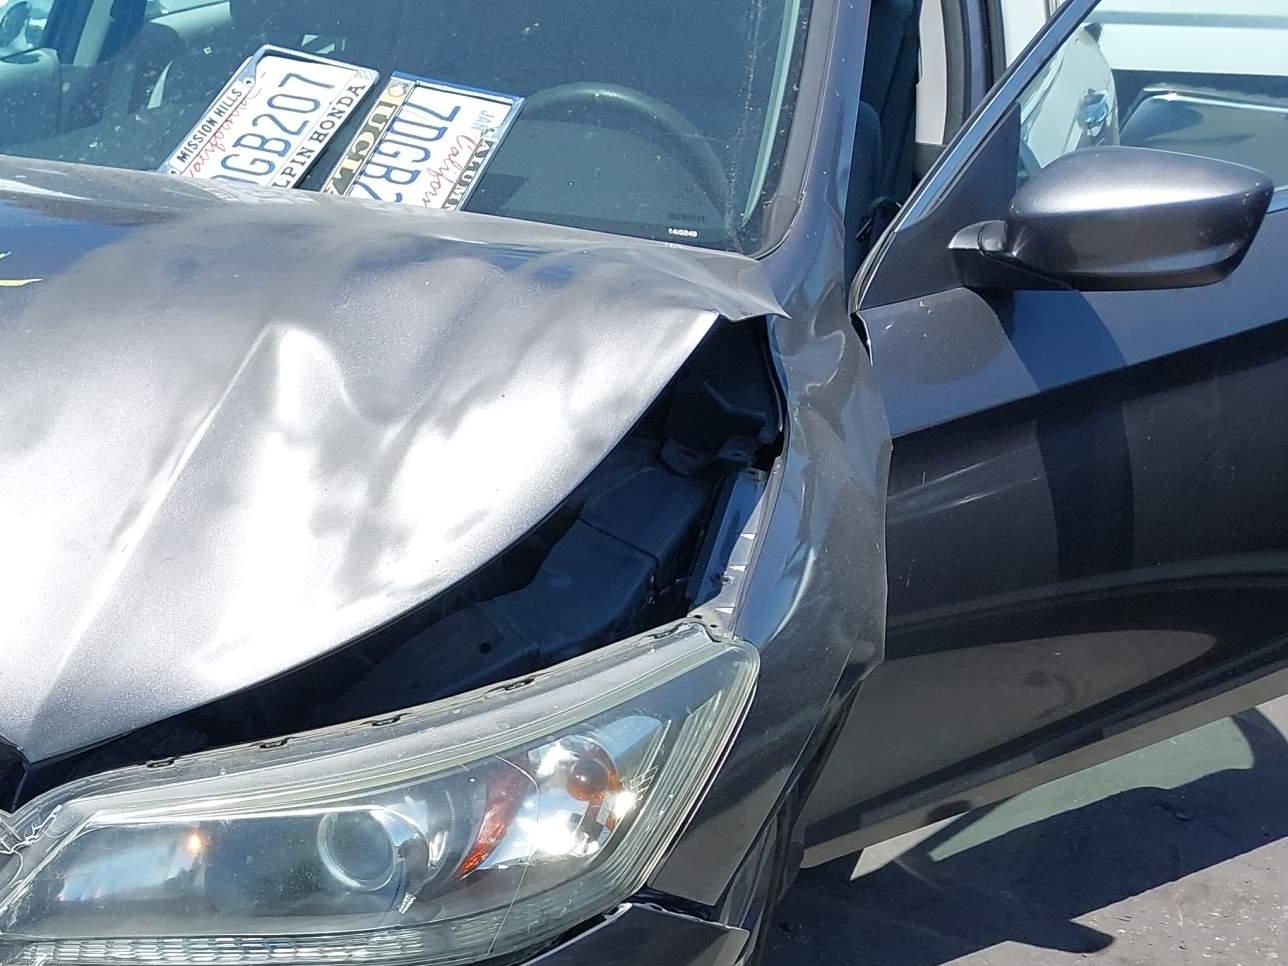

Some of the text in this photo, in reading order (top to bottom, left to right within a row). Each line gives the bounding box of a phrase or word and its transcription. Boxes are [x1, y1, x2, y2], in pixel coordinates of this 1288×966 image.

[176, 87, 242, 163] MISSION HILLS
[311, 84, 366, 144] HONDA
